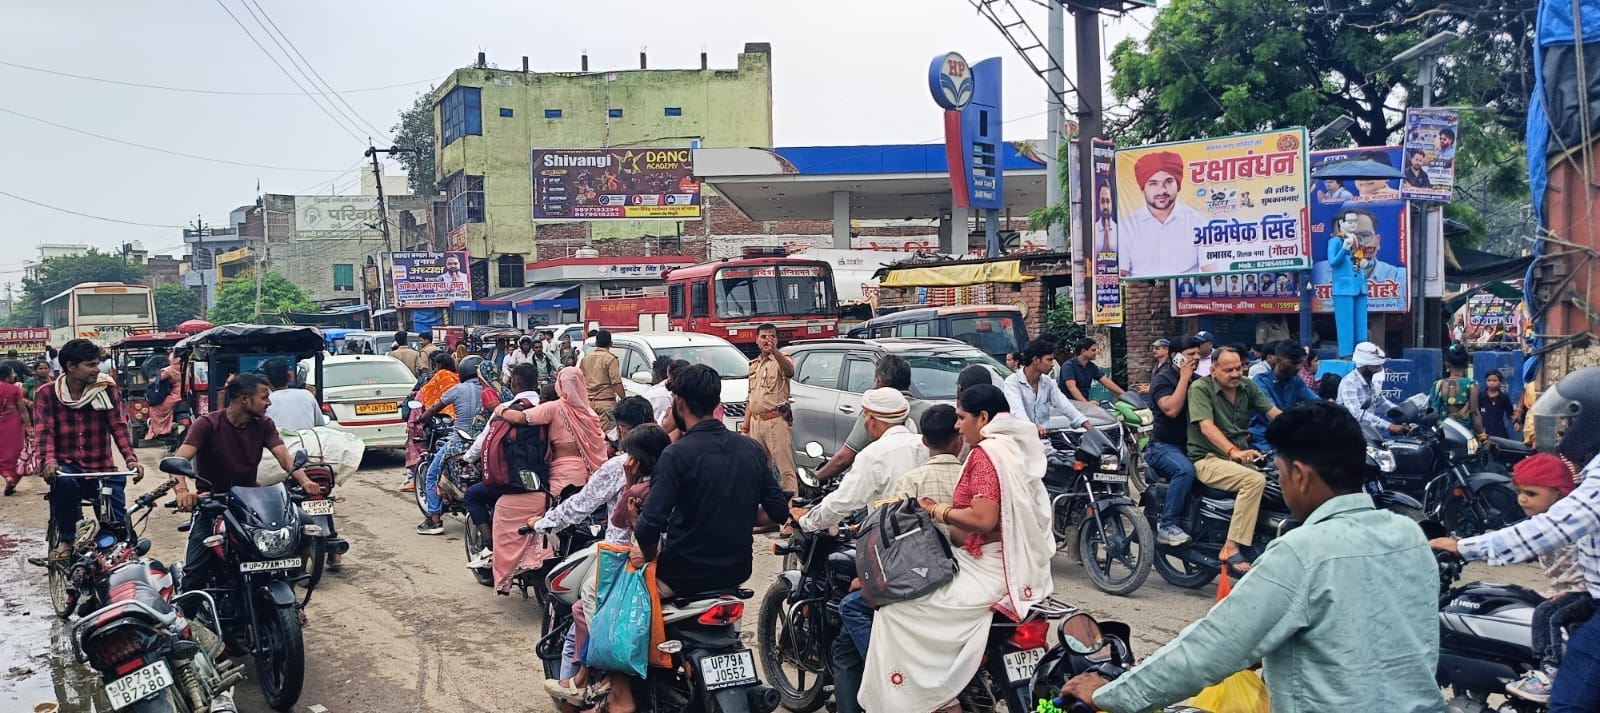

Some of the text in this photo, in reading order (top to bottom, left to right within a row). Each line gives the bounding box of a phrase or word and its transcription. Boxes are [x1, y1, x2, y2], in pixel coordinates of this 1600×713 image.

[948, 59, 965, 76] HP
[543, 153, 612, 168] Shivangi
[1189, 150, 1298, 183] रक्षाबंधन
[1192, 217, 1258, 245] अभिषेक
[1260, 212, 1297, 241] सिंह
[1206, 250, 1235, 260] सभासद,
[1268, 243, 1299, 258] (गौरव)
[1458, 599, 1480, 609] Hero
[710, 654, 744, 670] UP79A
[1014, 650, 1039, 665] UP79
[115, 664, 161, 692] UP79A
[715, 667, 746, 682] J0552
[1015, 664, 1037, 679] Y70
[121, 676, 166, 704] B7280
